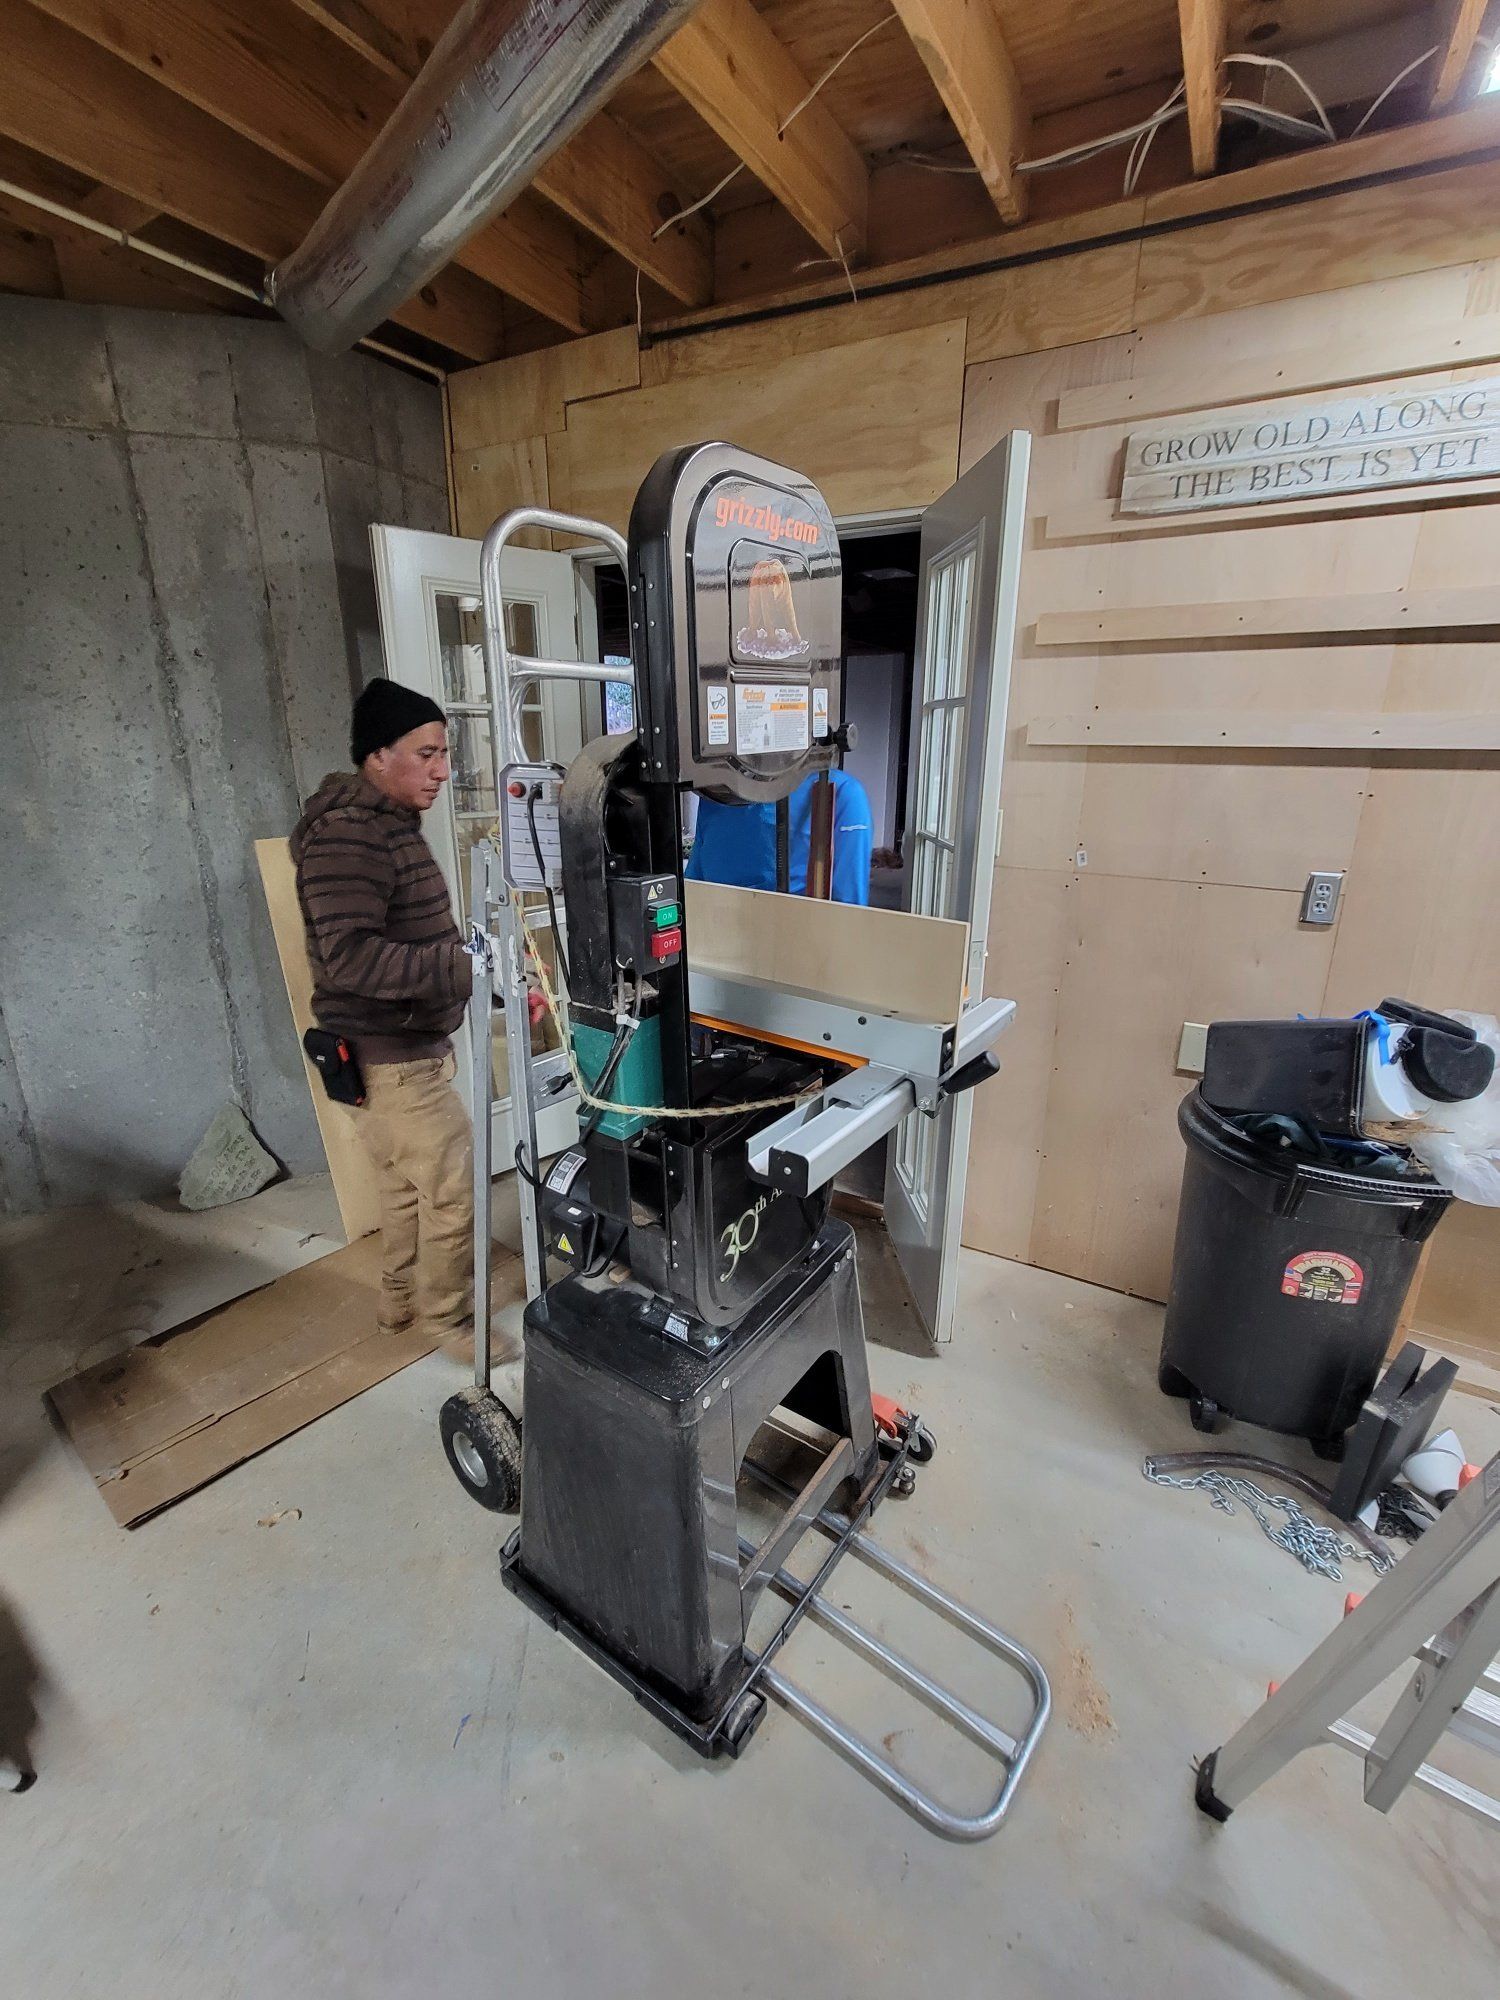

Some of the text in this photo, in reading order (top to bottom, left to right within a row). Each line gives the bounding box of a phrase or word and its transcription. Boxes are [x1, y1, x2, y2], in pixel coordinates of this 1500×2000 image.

[1141, 391, 1487, 467] GROW OLD ALONG
[1170, 437, 1488, 499] THE BEST IS YET
[716, 497, 819, 545] grizzly.com
[662, 912, 673, 921] ON
[663, 939, 677, 949] OFF
